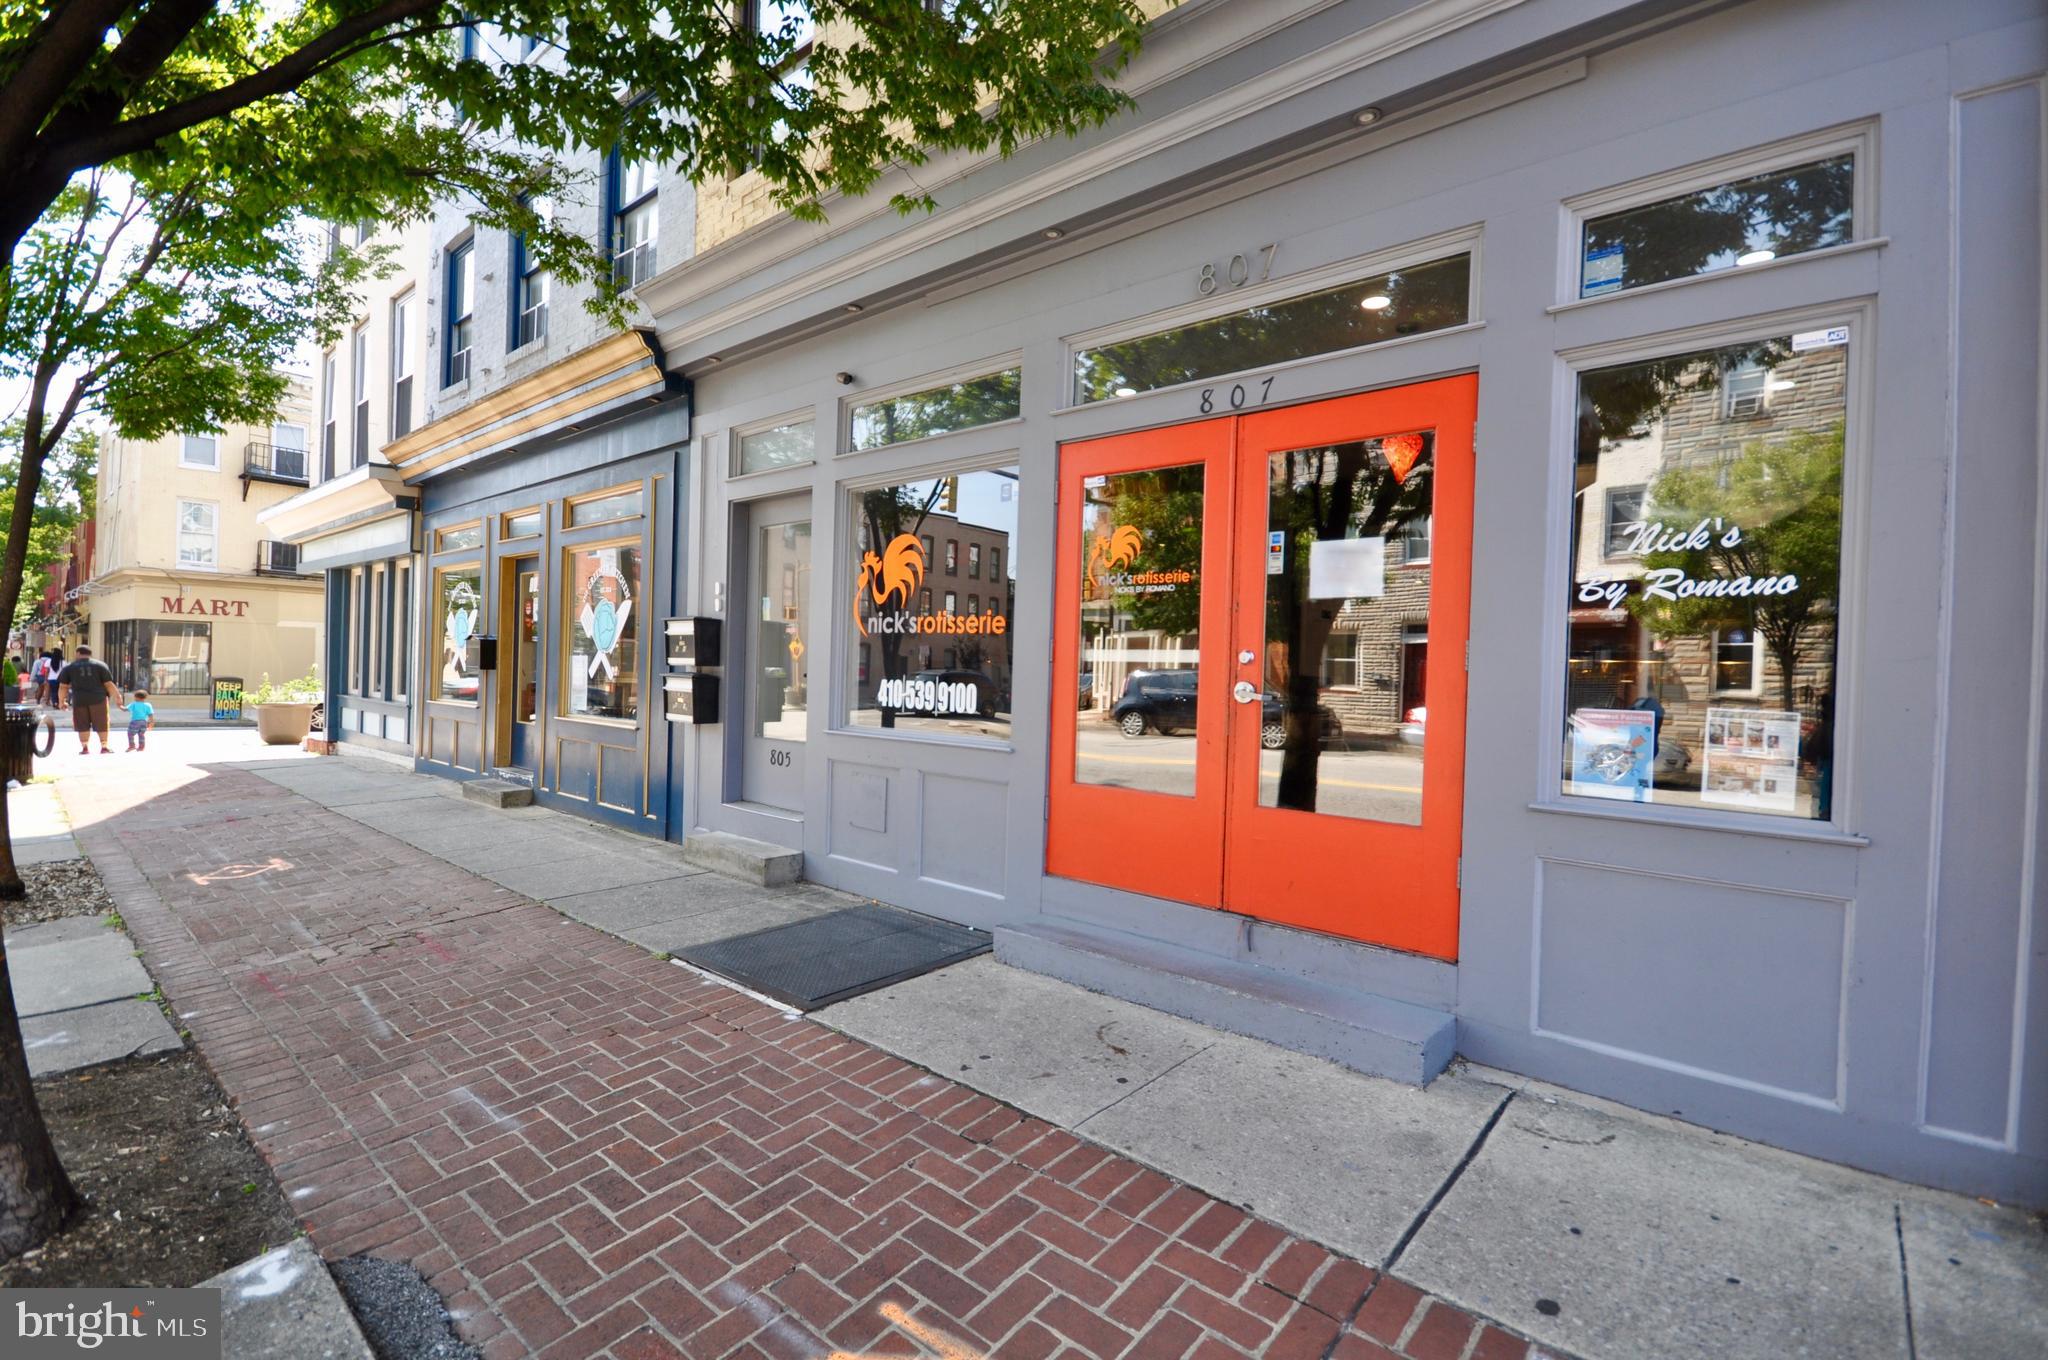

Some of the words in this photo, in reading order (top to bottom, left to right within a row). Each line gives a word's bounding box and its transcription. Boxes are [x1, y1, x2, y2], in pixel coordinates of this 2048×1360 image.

[1199, 243, 1278, 295] 807
[1200, 376, 1275, 414] 807
[1622, 517, 1742, 556] Nick's
[1578, 570, 1628, 610] By
[1642, 567, 1799, 602] Romano
[160, 597, 249, 617] MART
[216, 681, 241, 690] KEEP
[215, 700, 241, 710] MORE
[770, 749, 791, 768] 805
